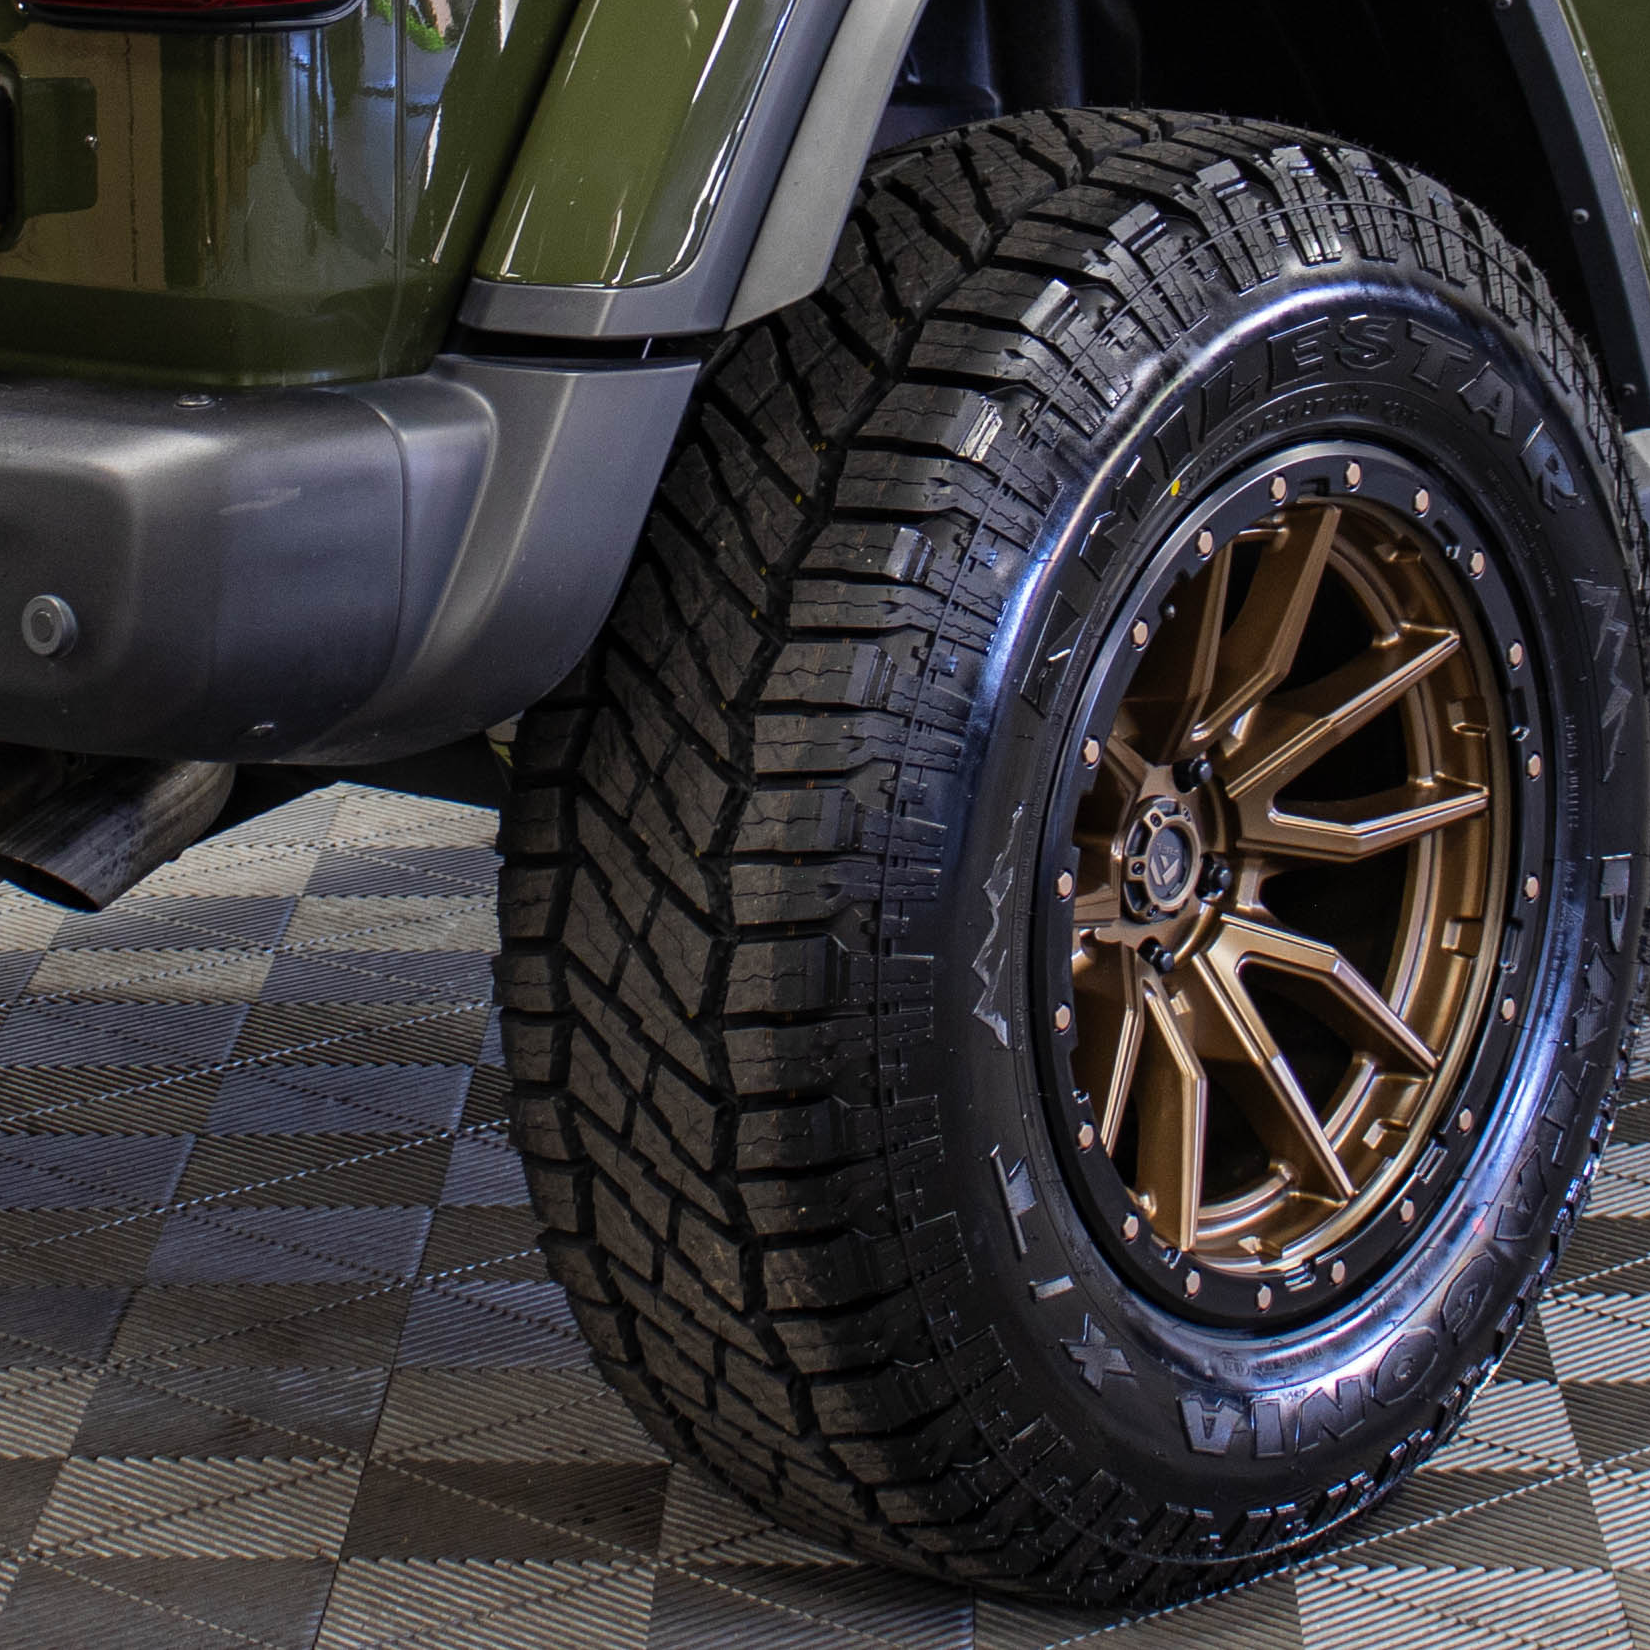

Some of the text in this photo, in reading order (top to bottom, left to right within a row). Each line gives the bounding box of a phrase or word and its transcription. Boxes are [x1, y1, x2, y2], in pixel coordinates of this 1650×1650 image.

[1077, 314, 1580, 580] MILESTAR
[990, 852, 1631, 1459] PATAGONIA X/T
